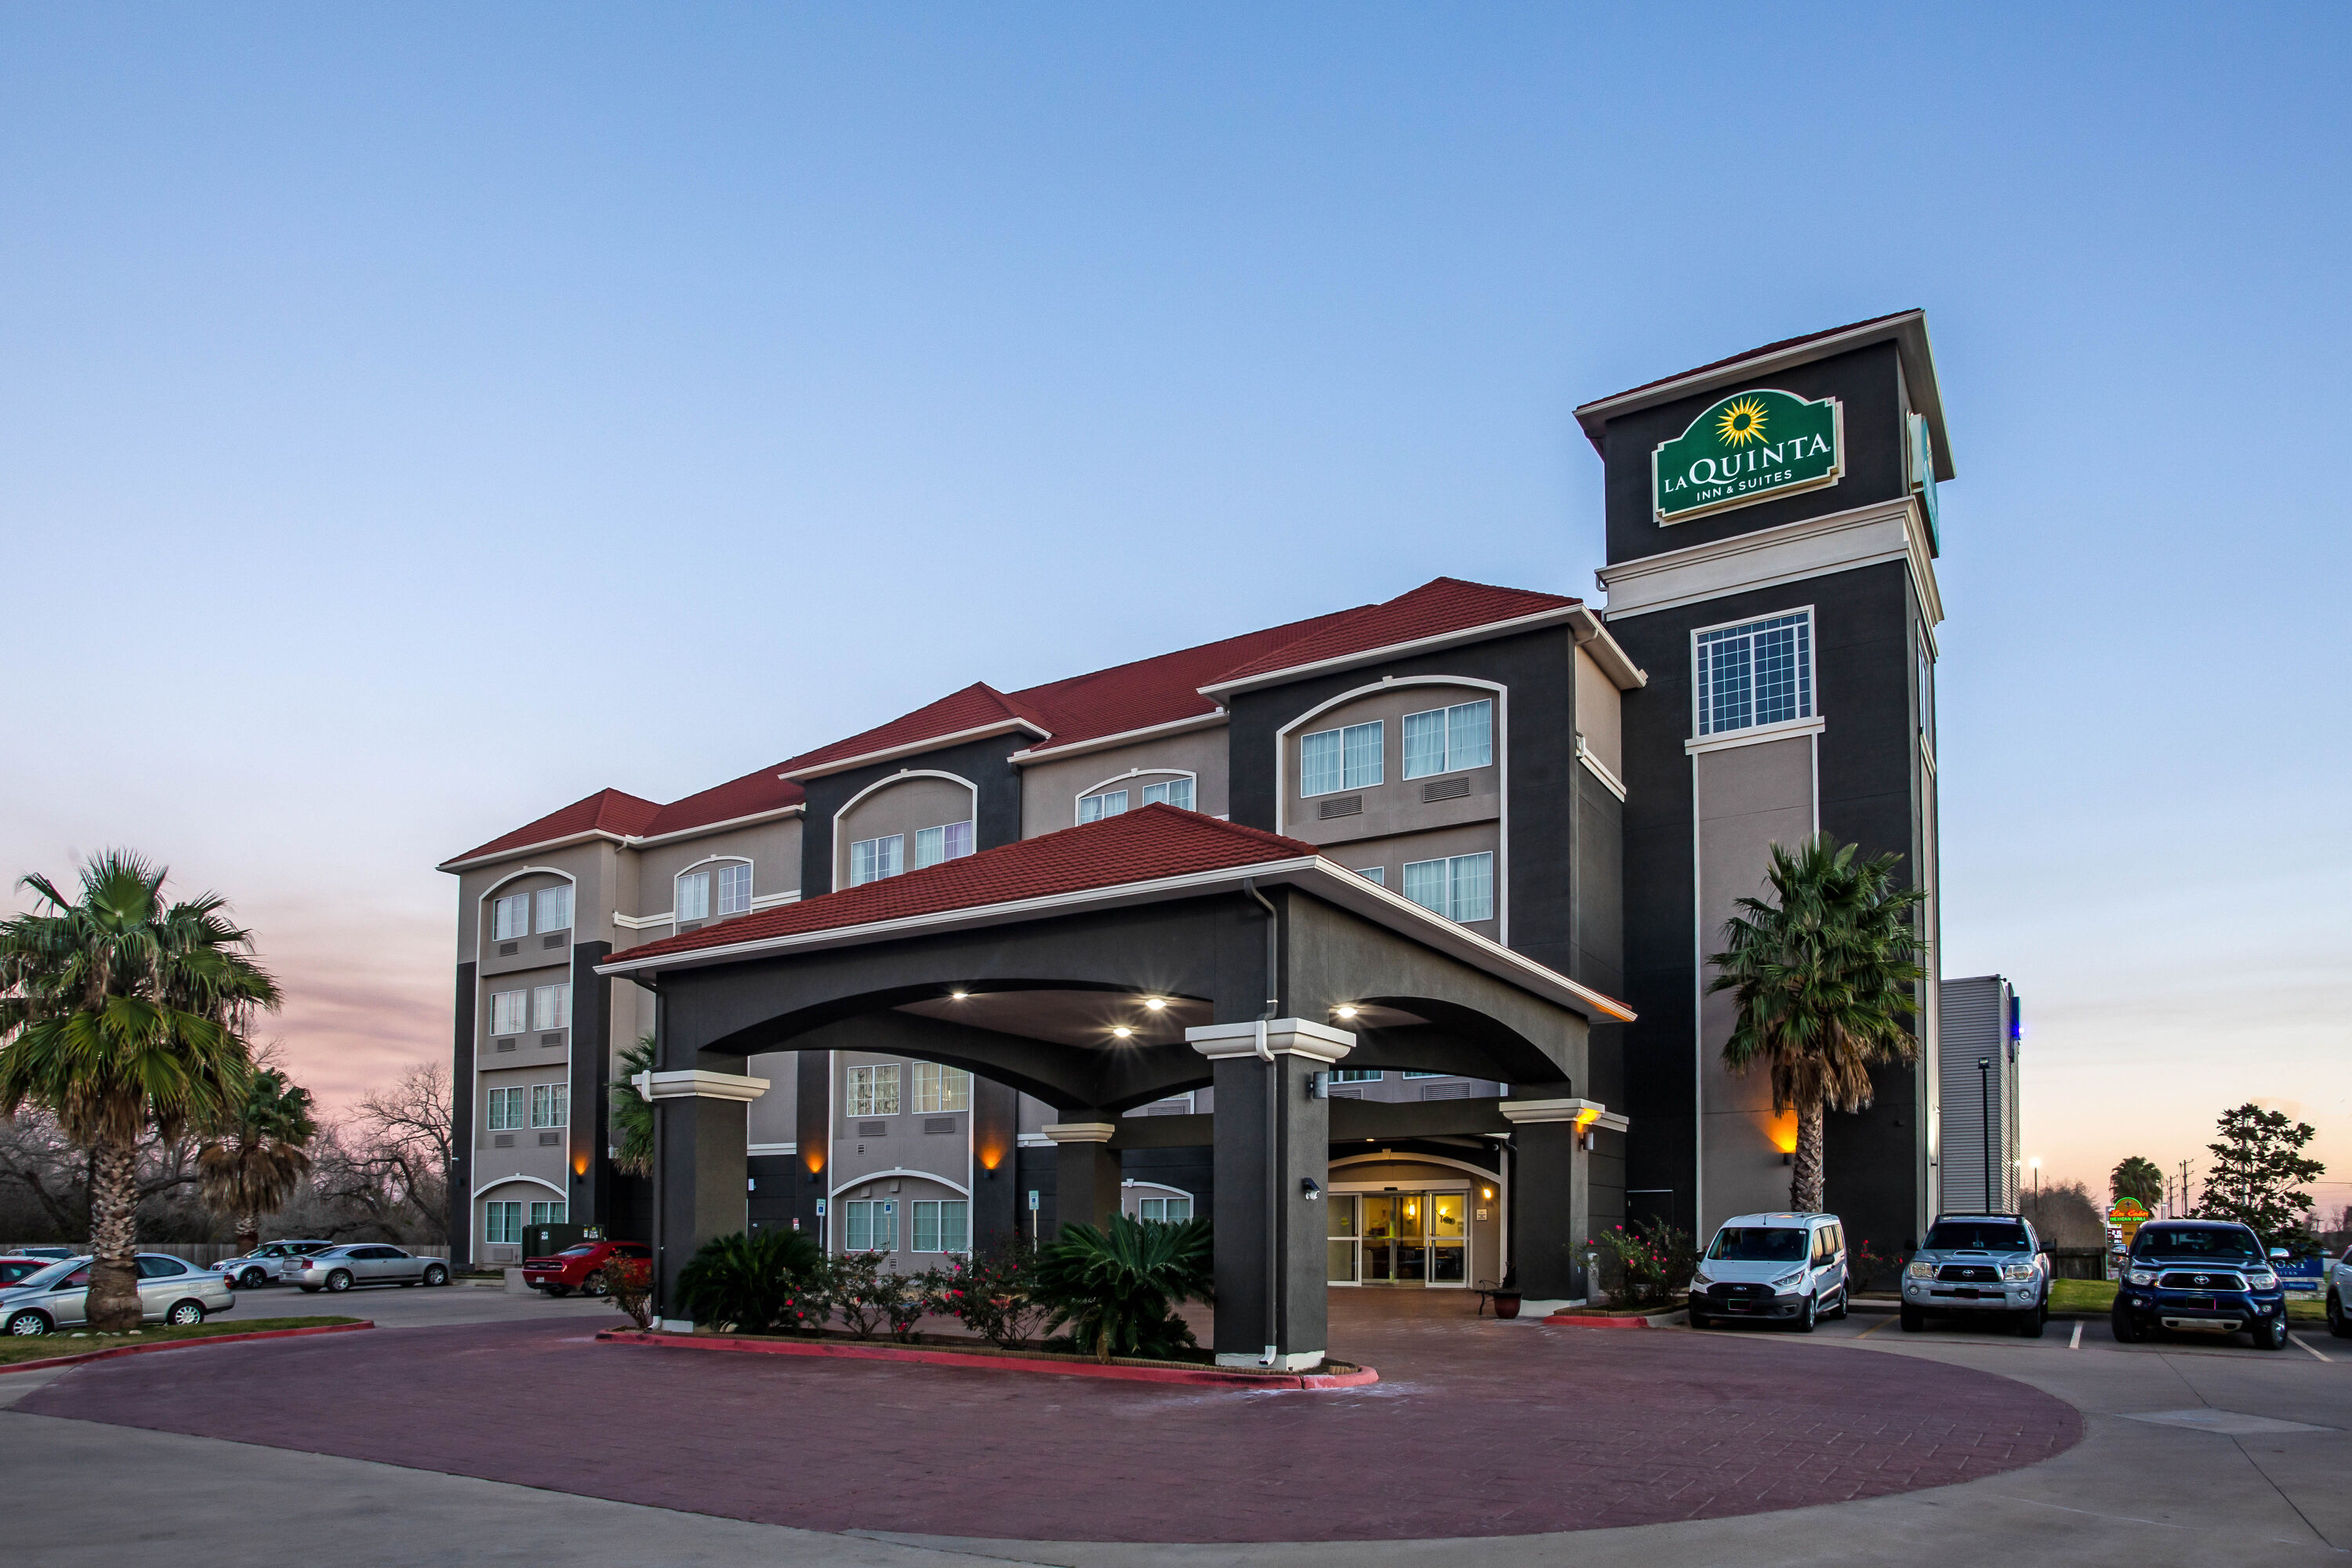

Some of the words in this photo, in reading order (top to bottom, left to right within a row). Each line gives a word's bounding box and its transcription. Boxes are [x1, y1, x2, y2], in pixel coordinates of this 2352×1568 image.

[1664, 475, 1689, 493] LA
[1689, 433, 1828, 485] QUINTA
[1697, 486, 1722, 502] INN
[1726, 485, 1733, 494] &
[1738, 469, 1792, 491] SUITES
